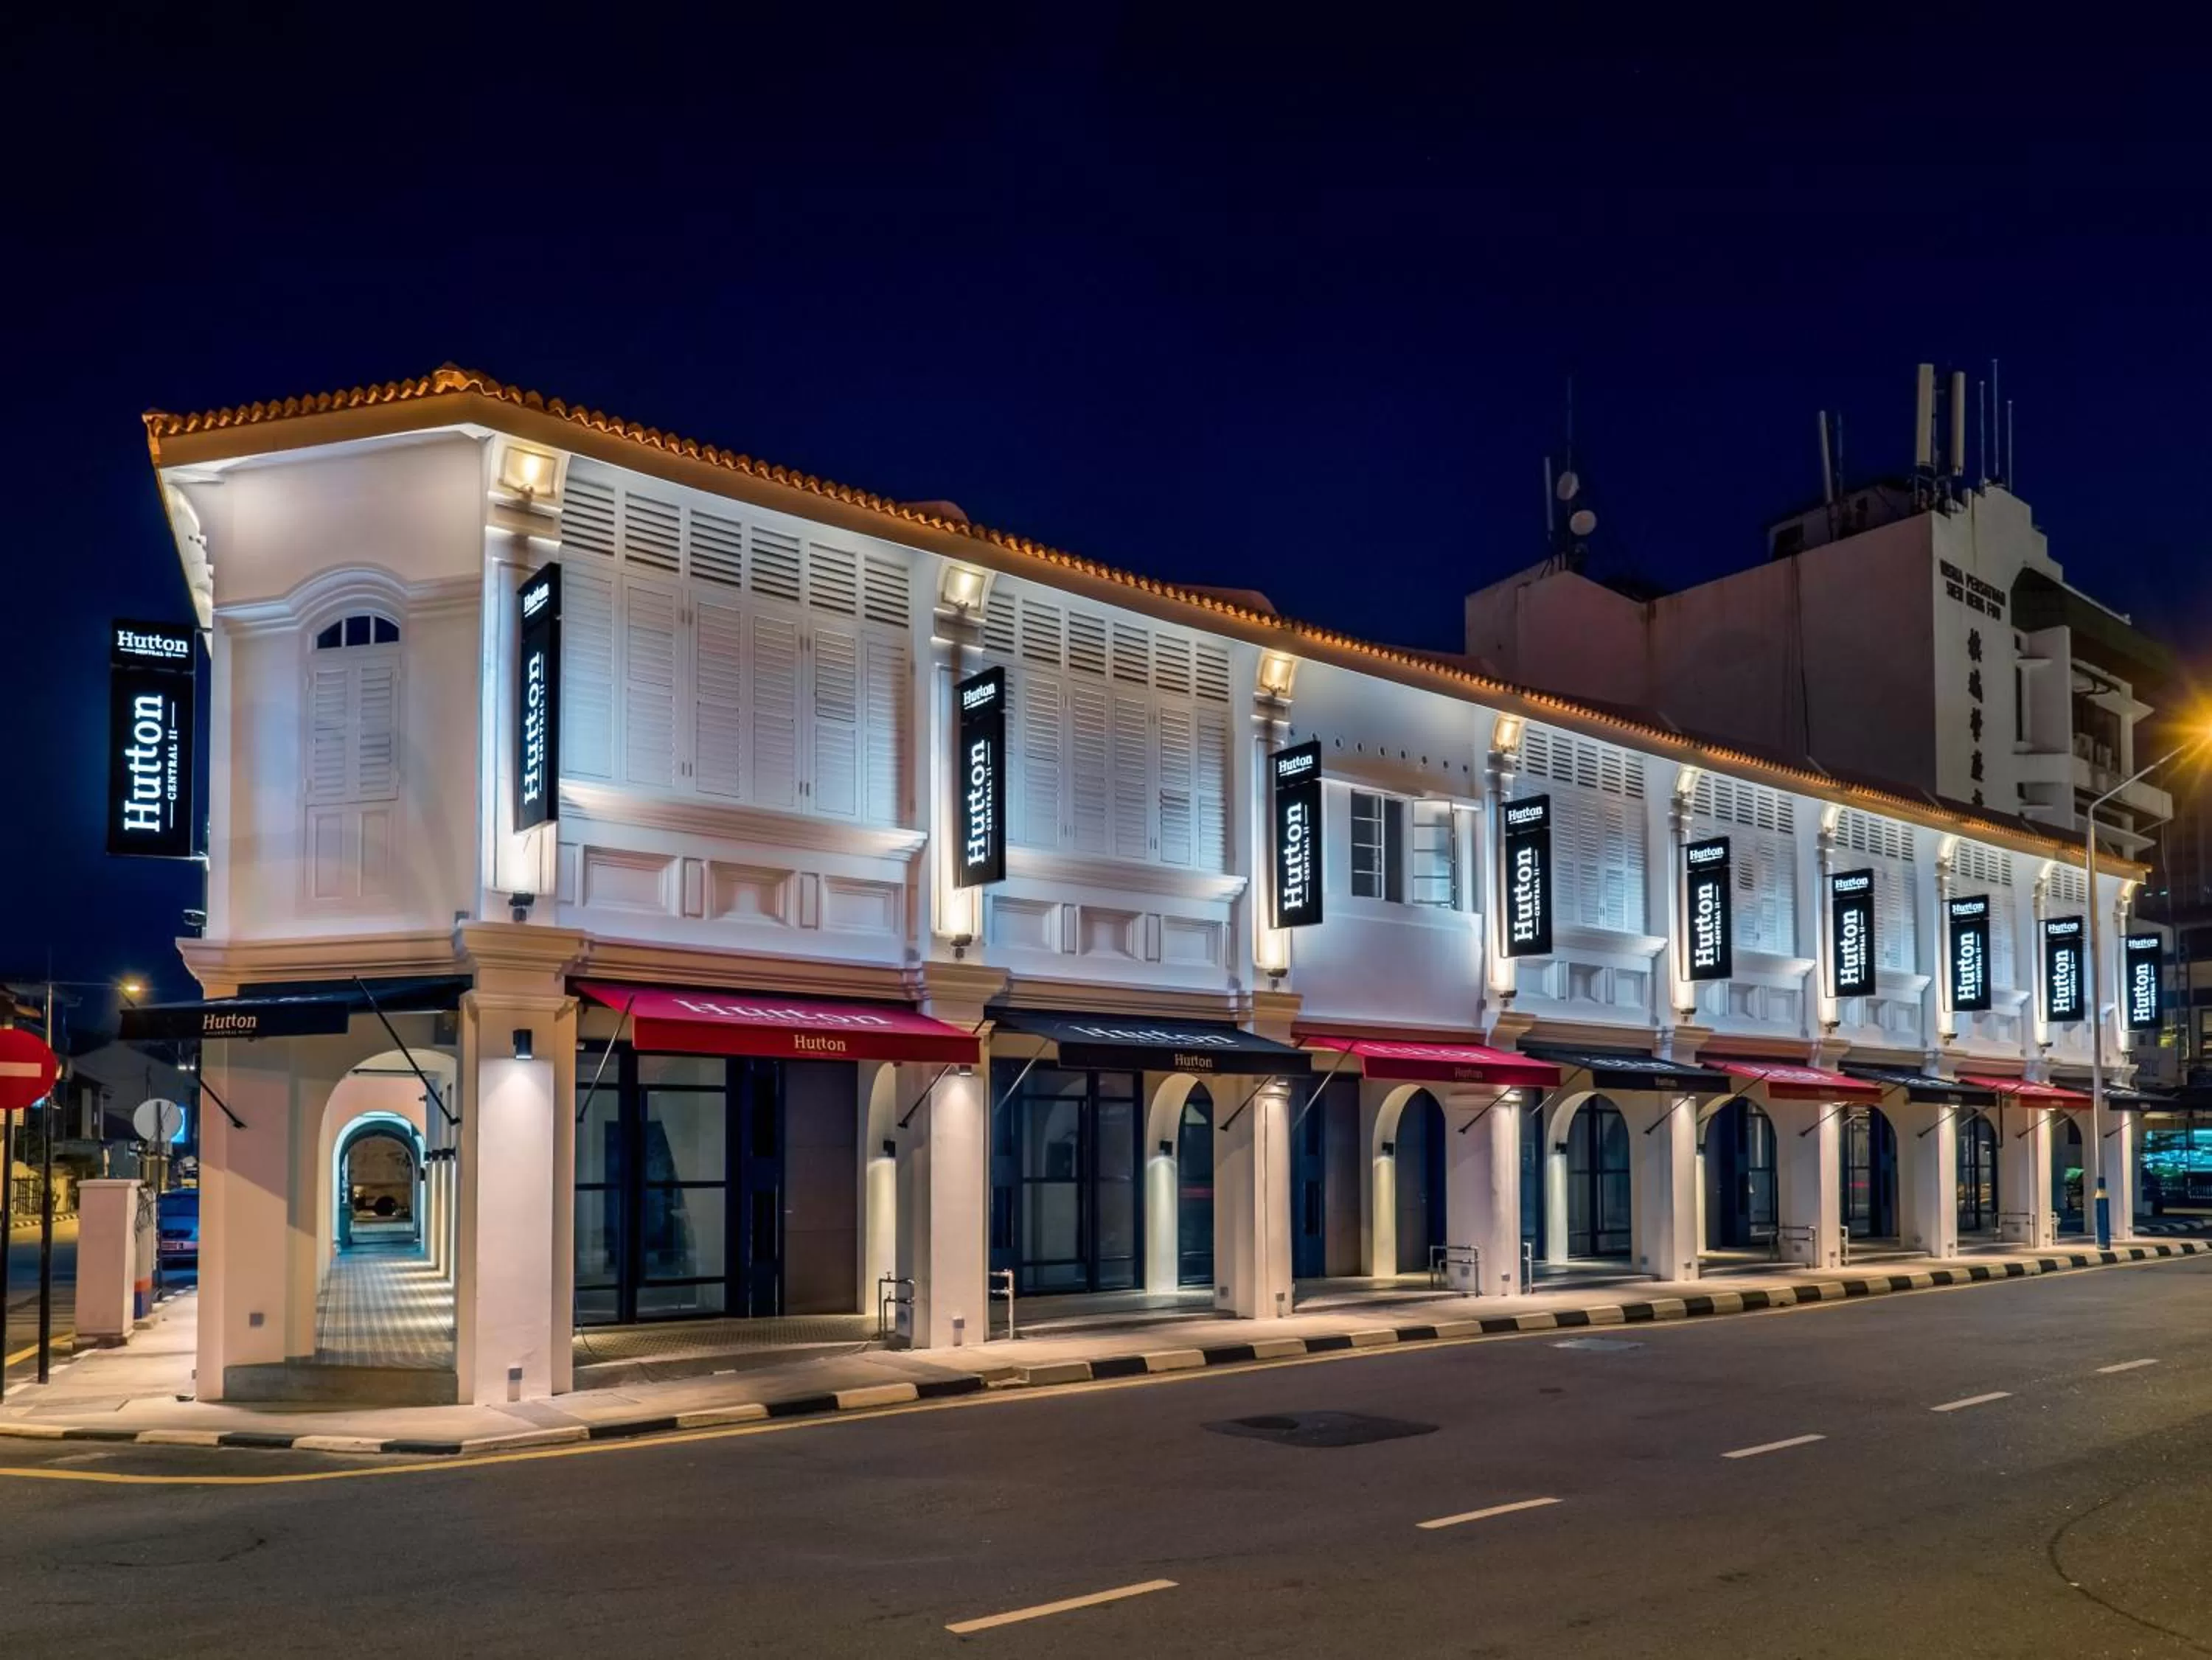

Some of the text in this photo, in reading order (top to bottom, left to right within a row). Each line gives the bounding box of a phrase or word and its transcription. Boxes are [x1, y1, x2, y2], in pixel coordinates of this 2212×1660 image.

[117, 630, 189, 653] Hutton
[964, 683, 995, 705] Hutton
[524, 652, 540, 805] Hutton
[124, 695, 163, 832] Hutton
[167, 729, 178, 801] CENTRAL II
[986, 767, 992, 775] II
[1278, 754, 1312, 773] Hutton
[968, 739, 986, 866] Hutton
[1508, 806, 1543, 822] Hutton
[1284, 802, 1302, 910] Hutton
[1689, 847, 1724, 860] Hutton
[1514, 847, 1533, 942] Hutton
[1834, 877, 1868, 889] Hutton
[1952, 902, 1984, 913] Hutton
[1694, 882, 1714, 968] Hutton
[1840, 909, 1859, 985] Hutton
[1957, 932, 1975, 1000] Hutton
[2052, 949, 2070, 1013] Hutton
[2132, 963, 2149, 1022] Hutton
[203, 1014, 257, 1030] Hutton
[672, 999, 892, 1024] Hutton
[793, 1034, 846, 1052] Hutton
[1175, 1053, 1213, 1067] Hutton
